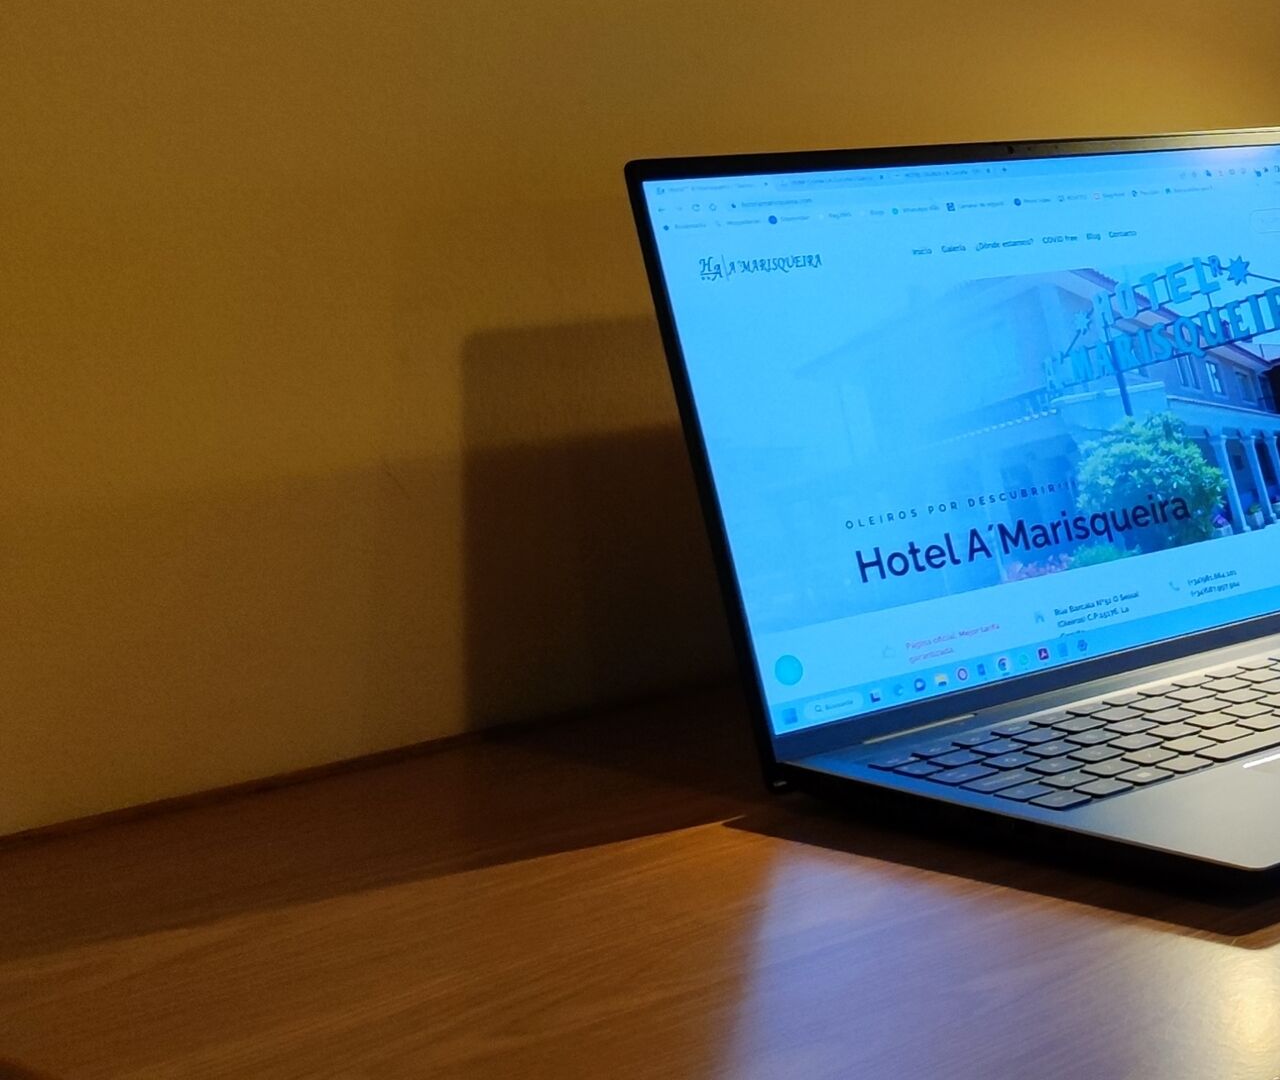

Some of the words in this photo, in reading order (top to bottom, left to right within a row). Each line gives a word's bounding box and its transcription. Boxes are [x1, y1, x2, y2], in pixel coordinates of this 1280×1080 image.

[1092, 256, 1221, 328] HOTEL
[845, 507, 917, 530] OLEIROS
[928, 501, 958, 515] POR
[855, 532, 962, 584] Hotel
